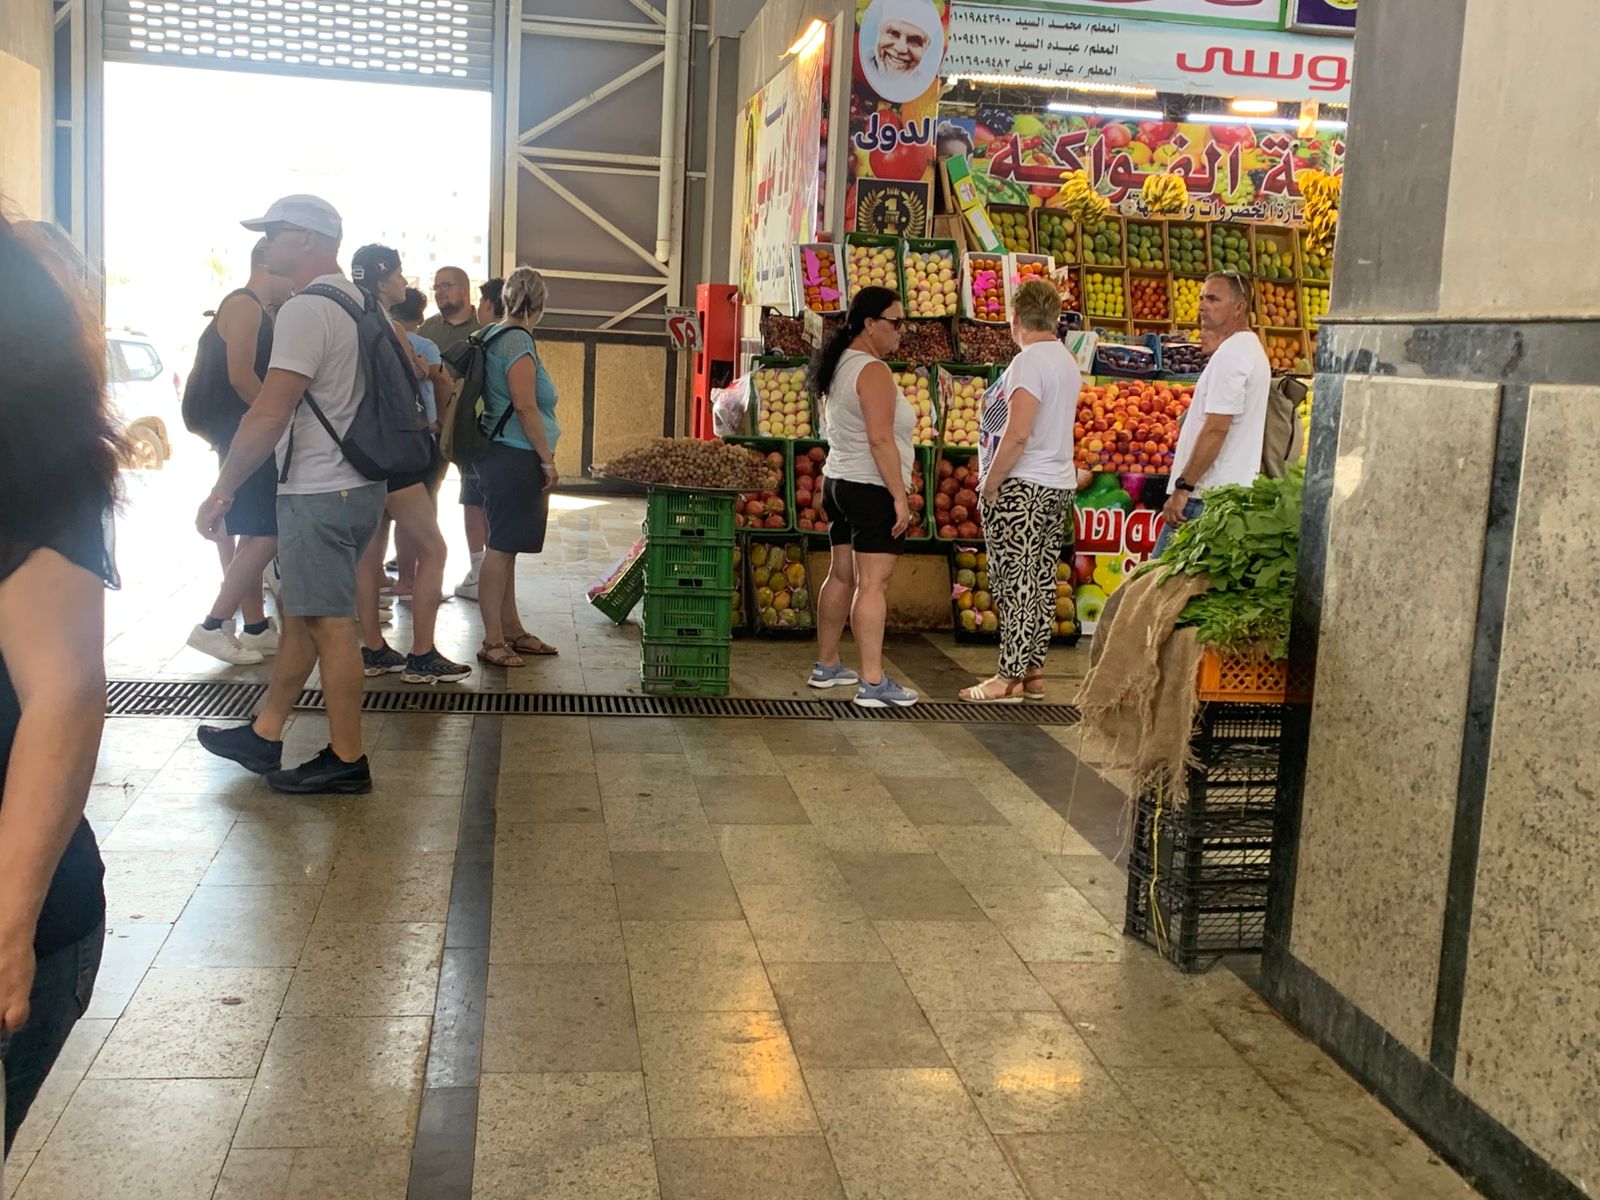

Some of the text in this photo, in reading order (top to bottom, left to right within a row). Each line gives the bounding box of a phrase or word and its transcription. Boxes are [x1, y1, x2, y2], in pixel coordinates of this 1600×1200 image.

[1015, 16, 1044, 30] السيد
[1048, 19, 1082, 30] محمد
[1014, 38, 1044, 51] السيد
[1047, 40, 1080, 55] عبده
[1038, 59, 1052, 76] أبو
[989, 130, 1242, 206] الفواكه
